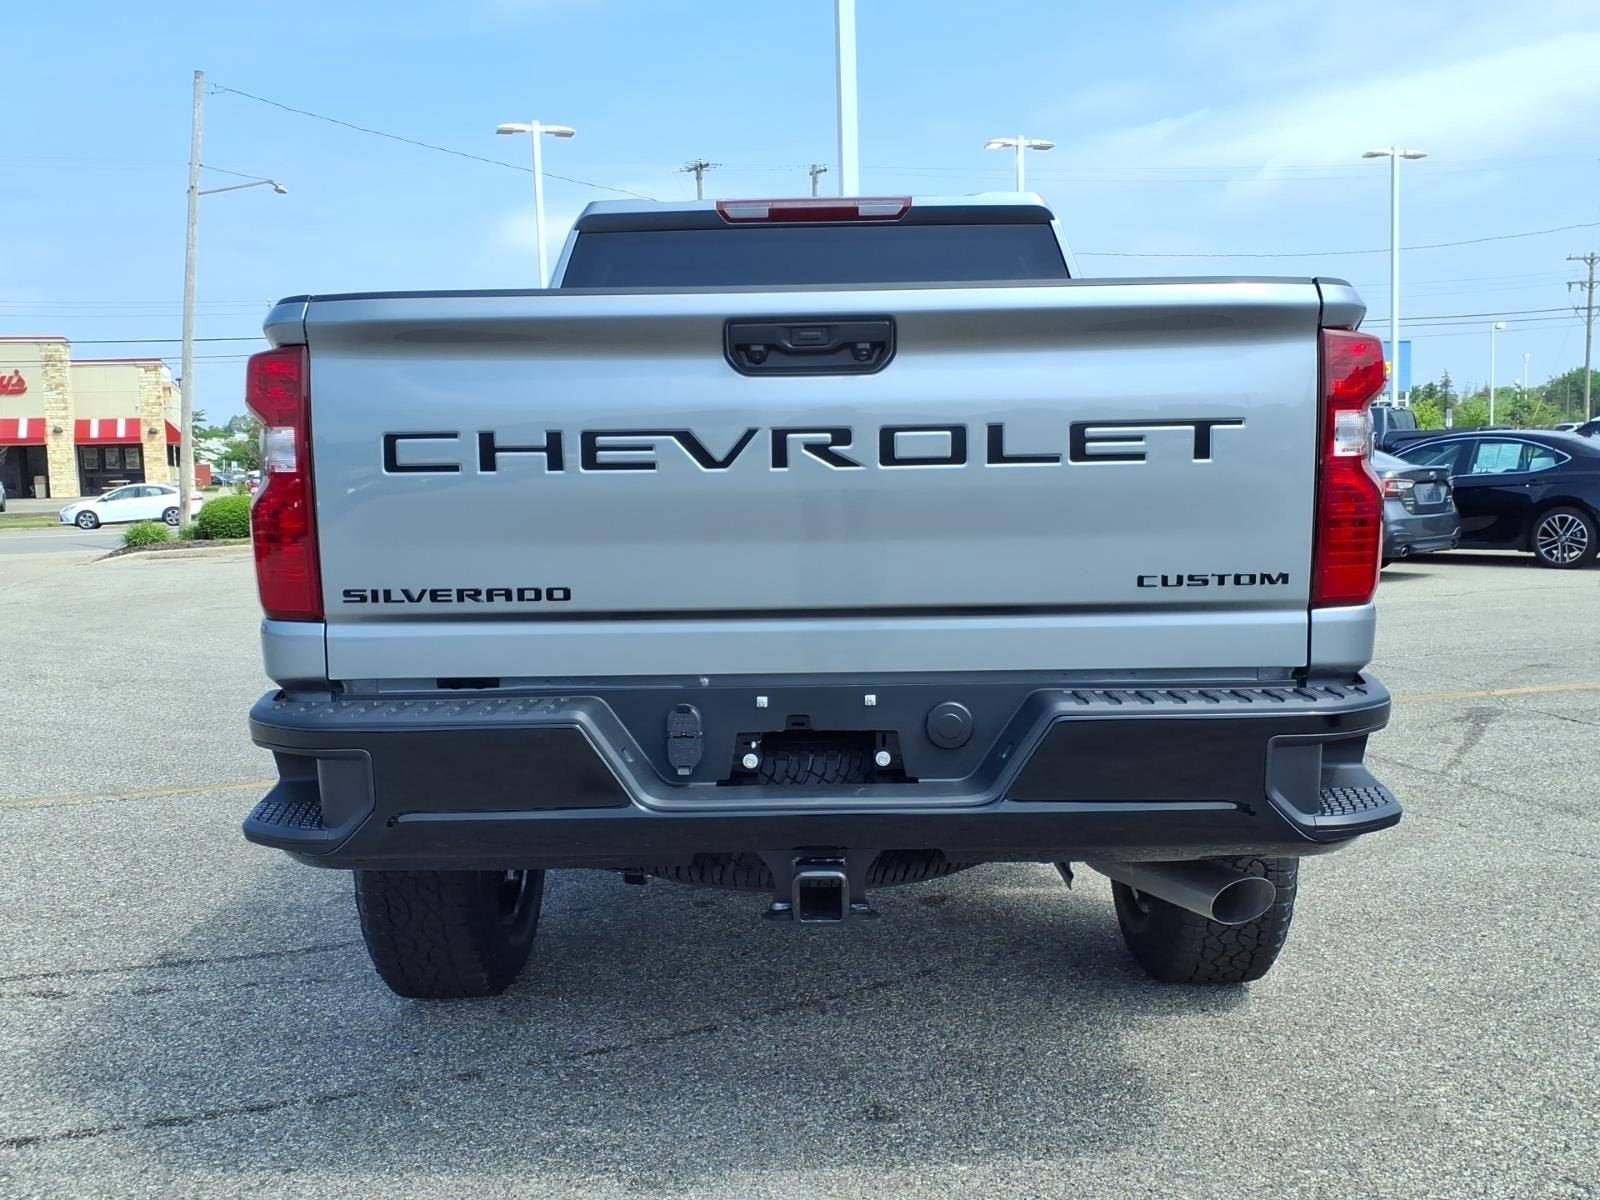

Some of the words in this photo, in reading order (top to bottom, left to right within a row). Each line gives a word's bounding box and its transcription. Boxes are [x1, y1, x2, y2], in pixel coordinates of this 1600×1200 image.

[383, 418, 1246, 474] CHEVROLET
[1137, 572, 1290, 588] CUSTOM
[343, 587, 571, 604] SILVERADO
